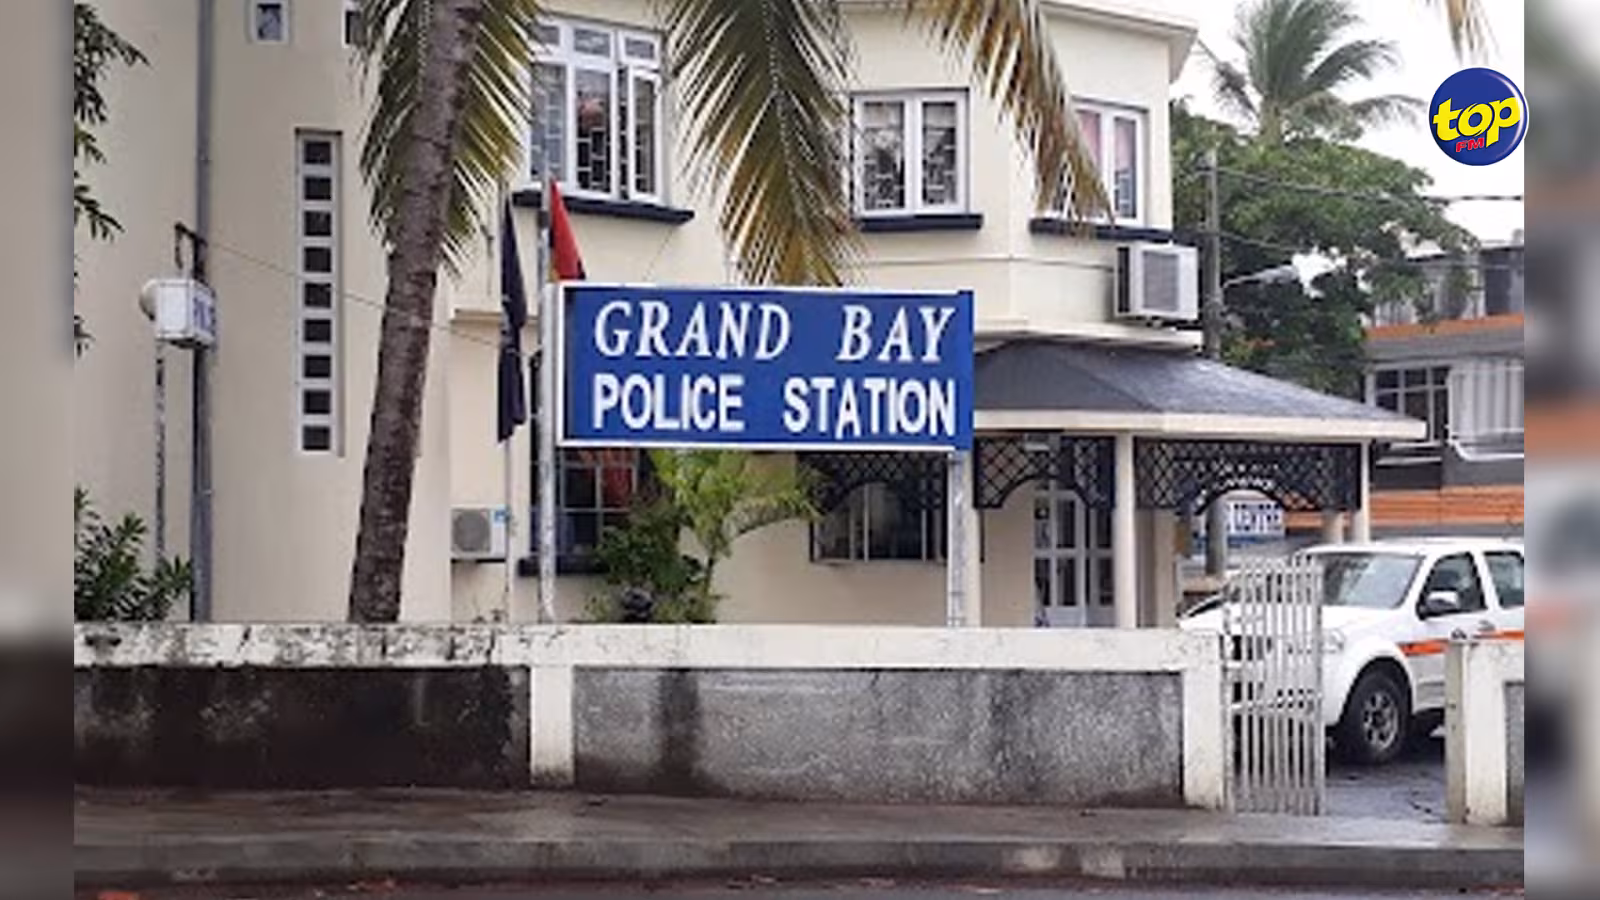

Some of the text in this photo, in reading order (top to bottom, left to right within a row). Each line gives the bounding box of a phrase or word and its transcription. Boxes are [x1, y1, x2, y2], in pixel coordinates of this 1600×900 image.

[595, 300, 956, 363] GRAND BAY
[593, 374, 956, 439] POLICE STATION
